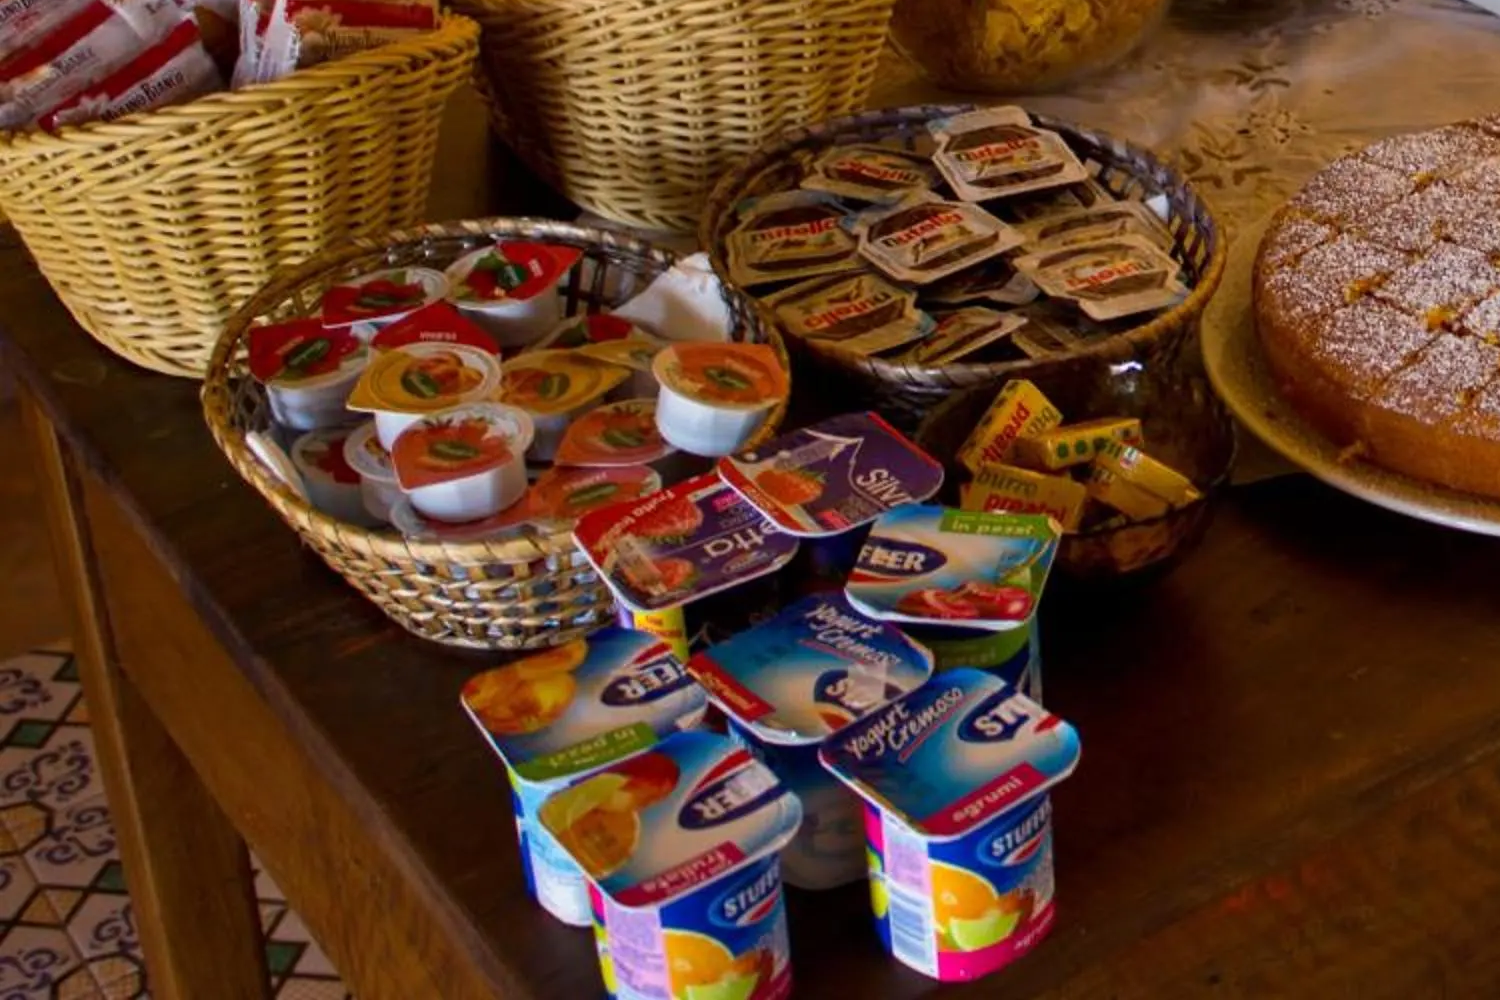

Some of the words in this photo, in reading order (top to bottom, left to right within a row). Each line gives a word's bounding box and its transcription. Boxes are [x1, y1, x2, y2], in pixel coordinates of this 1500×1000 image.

[954, 137, 1041, 163] nutella
[880, 209, 965, 248] nutella
[846, 700, 912, 761] Yogurt
[887, 687, 965, 751] Cremoso
